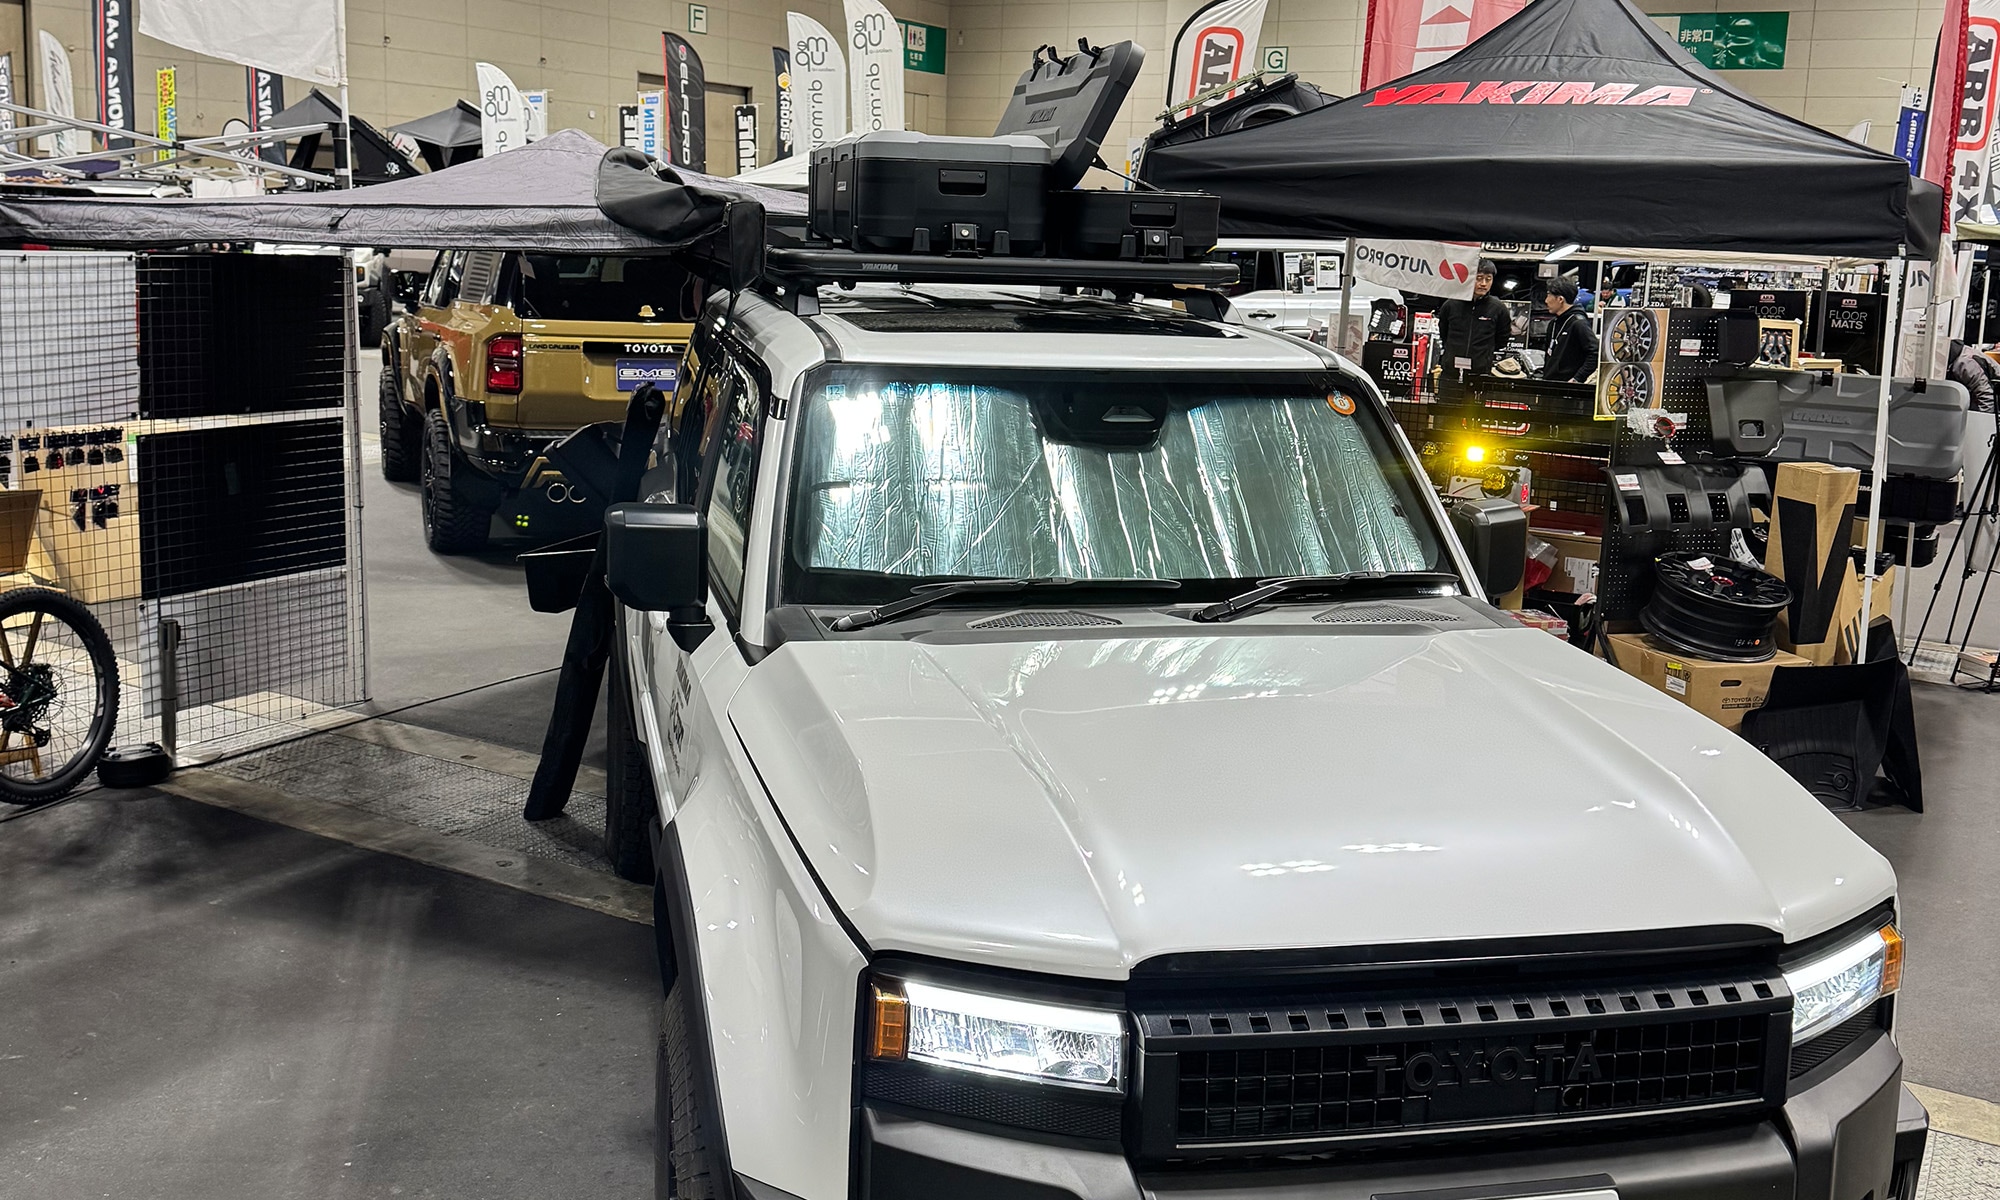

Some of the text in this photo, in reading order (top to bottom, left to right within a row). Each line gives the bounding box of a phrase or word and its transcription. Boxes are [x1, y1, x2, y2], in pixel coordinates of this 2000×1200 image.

[693, 9, 705, 29] F
[1680, 29, 1714, 43] 非常口
[1267, 51, 1284, 69] G
[1957, 30, 1994, 138] ARB
[1362, 80, 1698, 108] YAKIMA
[780, 90, 792, 141] KADDIS
[1906, 111, 1919, 158] LADDER
[738, 114, 756, 174] HULE
[861, 262, 899, 271] YAKIMA
[1750, 305, 1786, 316] FLOOR
[1828, 309, 1868, 321] FLOOR
[1830, 319, 1864, 330] MATS
[624, 343, 674, 353] TOYOTA
[1381, 360, 1411, 371] FLOO
[1366, 1042, 1603, 1095] TOYOTA
